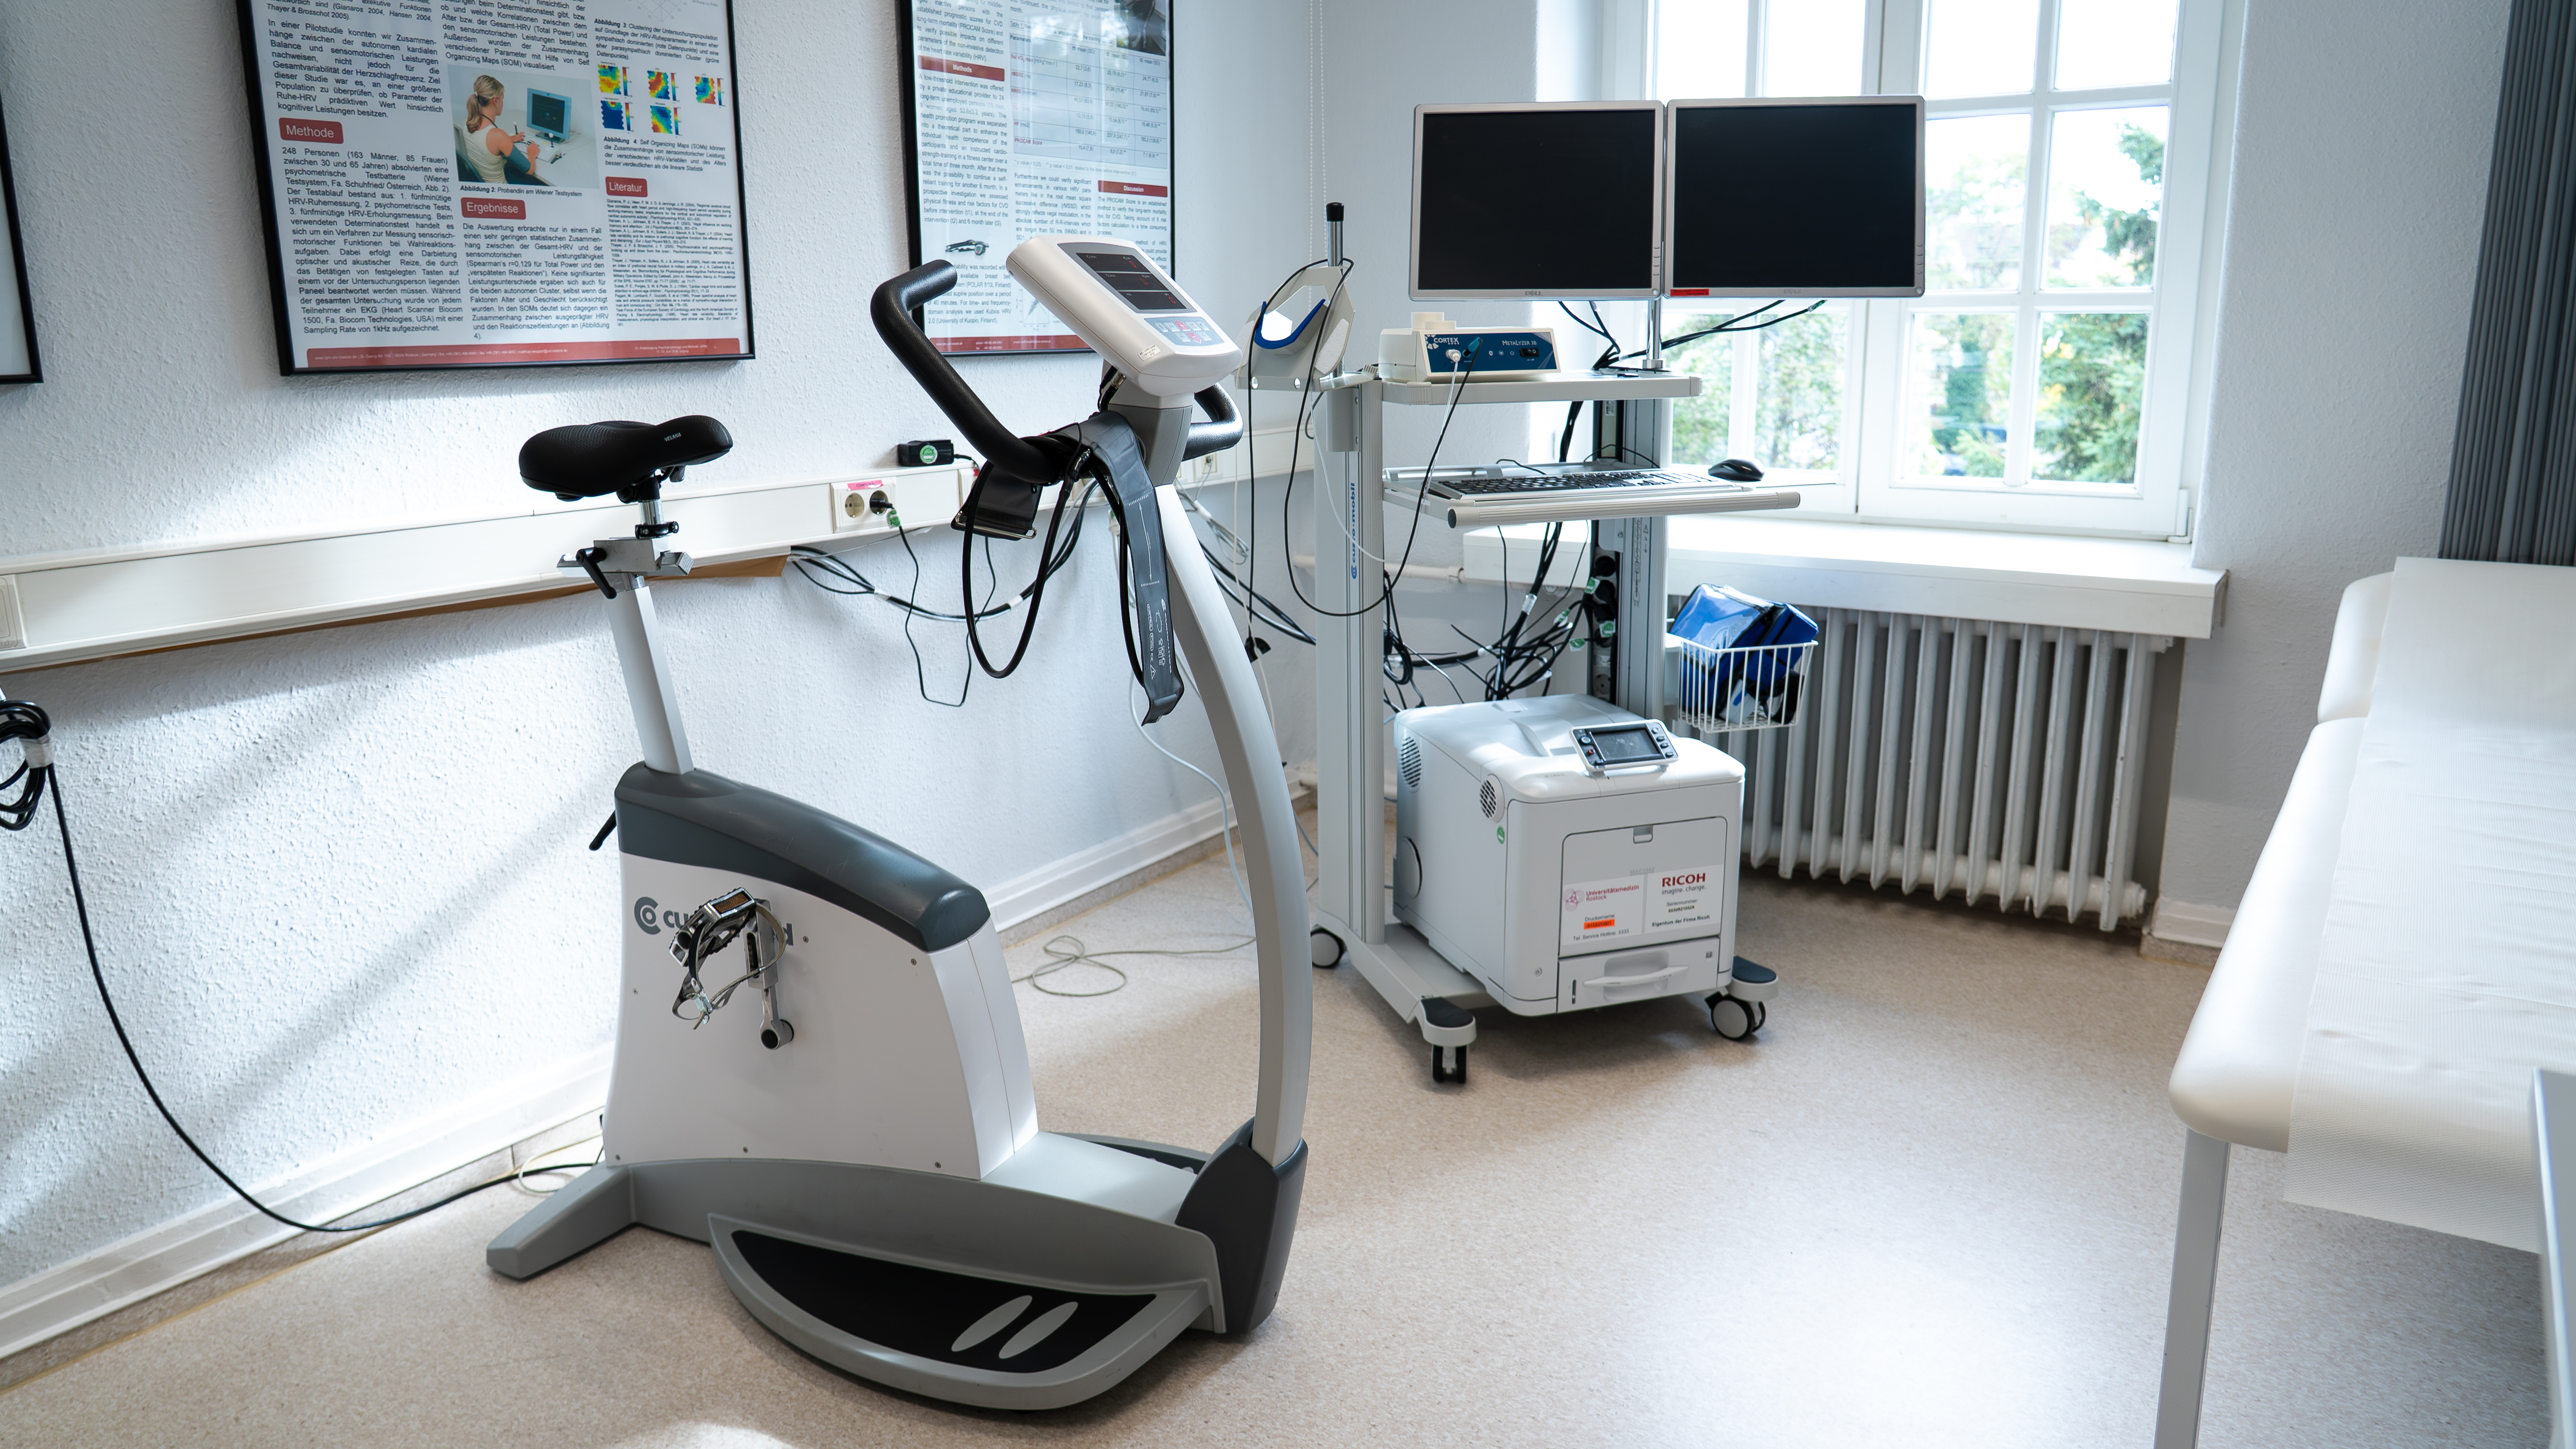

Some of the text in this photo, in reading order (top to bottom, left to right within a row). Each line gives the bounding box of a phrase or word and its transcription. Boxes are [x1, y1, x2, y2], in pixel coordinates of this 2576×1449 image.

[268, 18, 275, 26] In
[305, 22, 343, 34] Pilotstudie
[348, 28, 377, 38] konnten
[269, 28, 293, 40] hänge
[301, 34, 335, 43] zwischen
[361, 41, 400, 51] autonomen
[407, 45, 438, 55] kardialen
[270, 39, 302, 50] Balance
[330, 47, 395, 60] sensomotorischen
[401, 54, 439, 65] Leistungen
[271, 51, 318, 63] nachweisen,
[334, 57, 352, 65] nicht
[367, 61, 390, 69] jedoch
[445, 51, 557, 71] Organizing Maps (SOM) visualisiert.
[272, 60, 340, 74] Gesamtvariabilität
[428, 76, 440, 84] Ziel
[952, 64, 972, 73] Methods
[274, 71, 297, 80] dieser
[304, 73, 328, 83] Studie
[411, 85, 441, 93] größeren
[275, 81, 315, 91] Population
[391, 92, 427, 102] Parameter
[276, 91, 443, 113] Ruhe-HRV prädiktiven Wert hinsichtlich
[277, 102, 389, 118] kognitiver Leistungen besitzen.
[286, 125, 334, 138] Methode
[282, 146, 296, 155] 248
[304, 148, 340, 157] Personen
[347, 151, 363, 159] (163
[370, 152, 399, 161] Männer,
[421, 155, 448, 165] Frauen)
[362, 162, 388, 171] Jahren)
[391, 163, 432, 172] absolvierten
[284, 168, 449, 183] psychometrische Testbatterie (Wiener
[286, 177, 329, 187] Testsystem,
[609, 181, 642, 192] Literatur
[466, 201, 519, 215] Ergebnisse
[477, 224, 514, 233] Auswertung
[303, 326, 337, 335] Sampling
[392, 325, 440, 333] aufgezeichnet.
[1662, 872, 1706, 887] RICOH
[1586, 885, 1639, 896] Universitätsmedizin
[1661, 887, 1684, 895] imagine.
